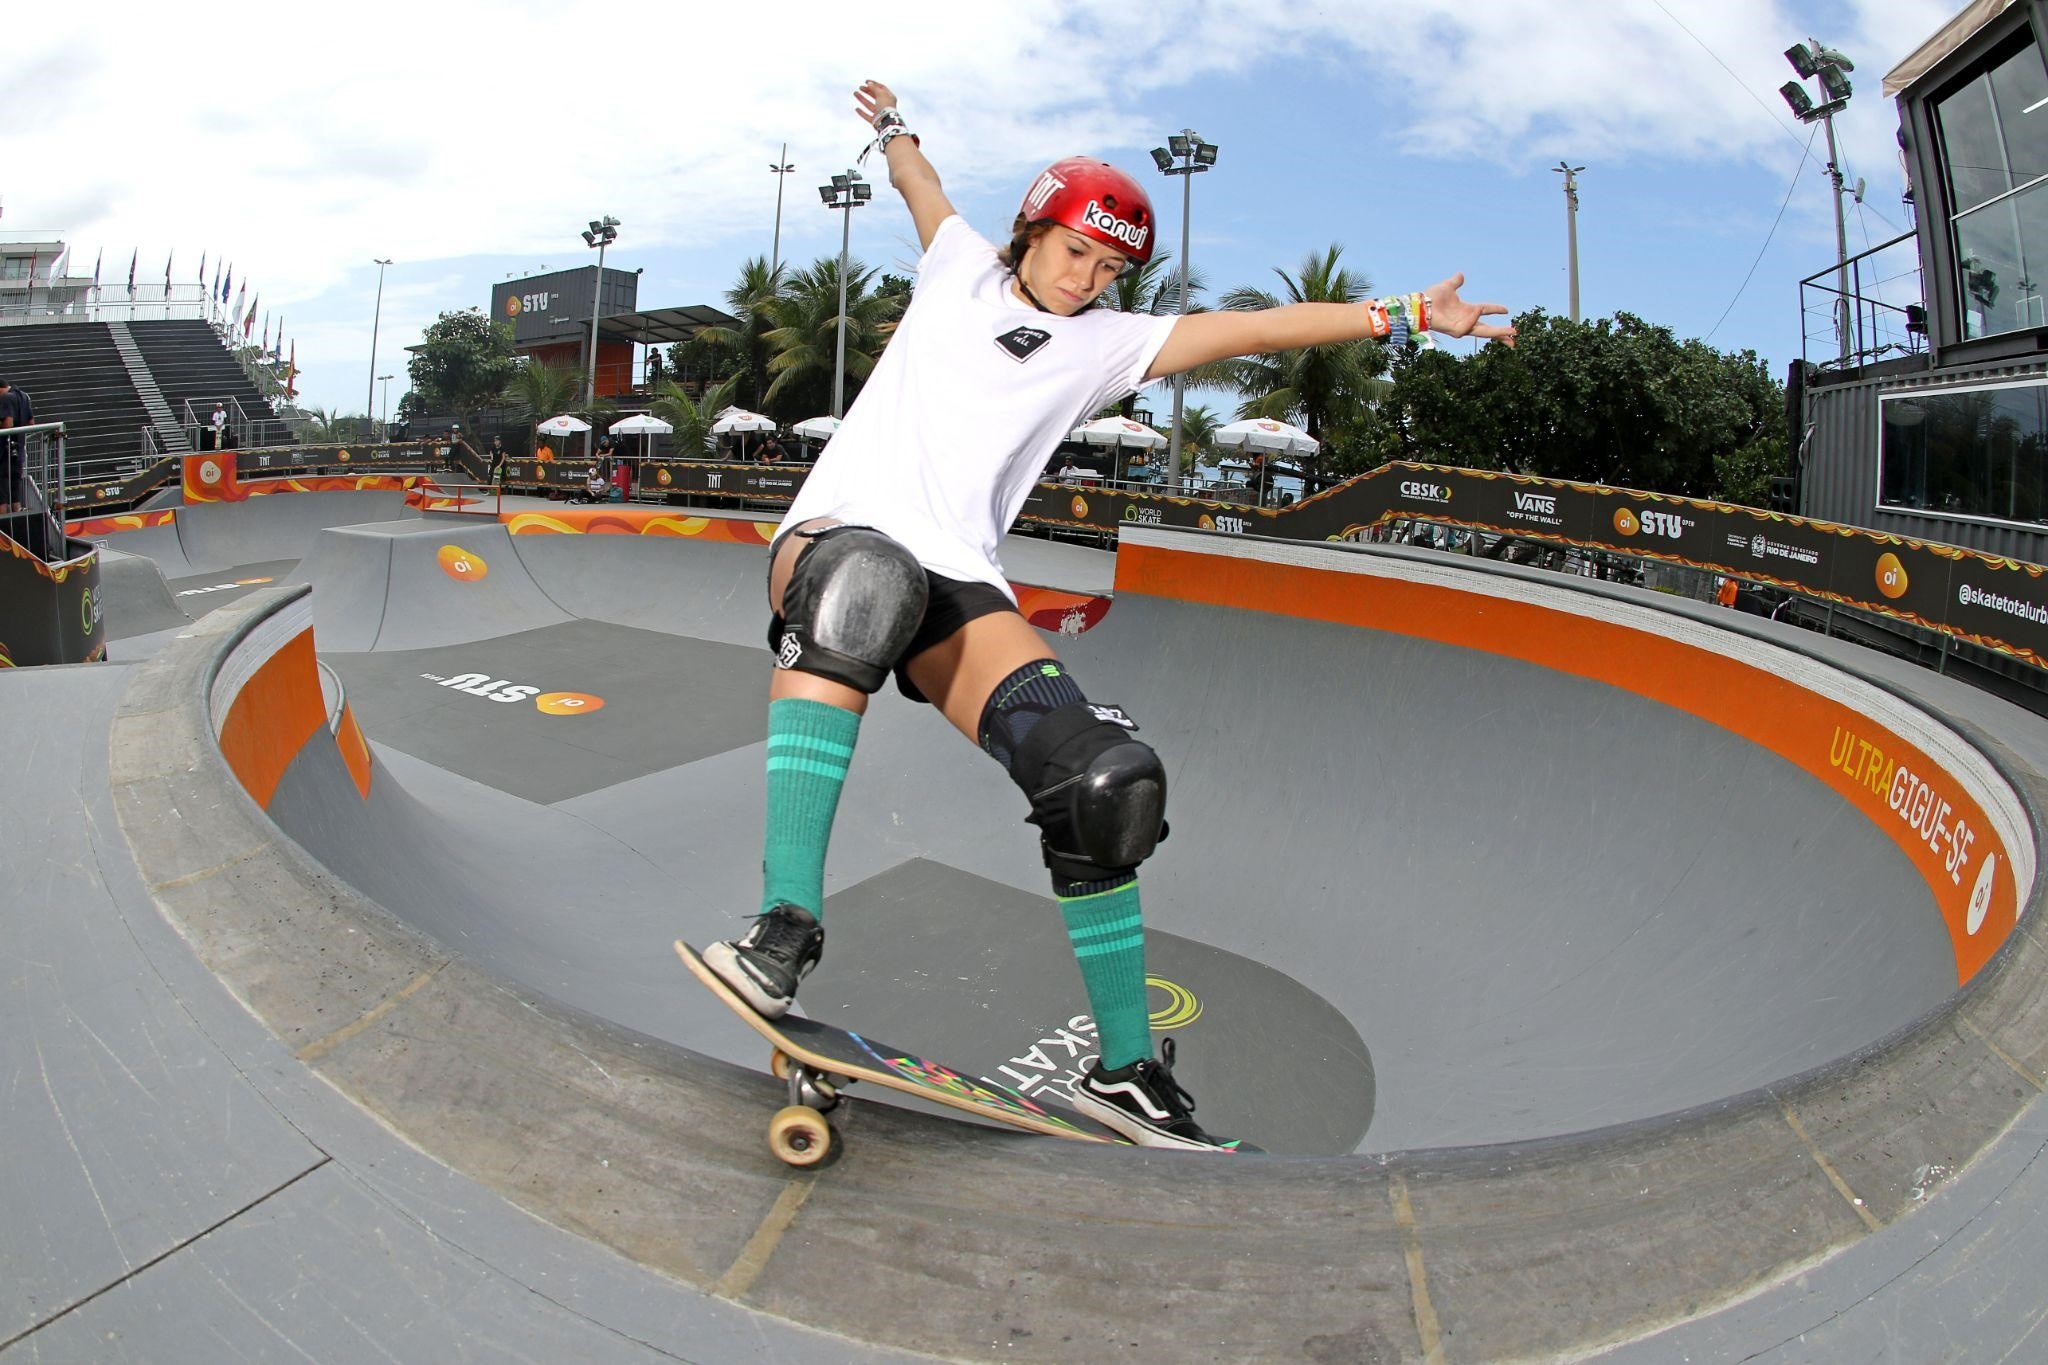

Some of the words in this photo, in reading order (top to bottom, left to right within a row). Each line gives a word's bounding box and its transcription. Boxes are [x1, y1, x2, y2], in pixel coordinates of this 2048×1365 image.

[1028, 171, 1066, 210] TNT
[1083, 201, 1148, 249] kanui
[523, 292, 548, 313] STU
[259, 456, 271, 467] TNT
[206, 468, 215, 478] oi
[707, 474, 722, 488] TNT
[1076, 502, 1083, 512] oi
[1514, 491, 1557, 514] VANS
[1138, 515, 1161, 525] SKATE
[1139, 508, 1162, 517] WORLD
[1525, 513, 1539, 522] THE
[1216, 515, 1243, 534] STU
[1620, 517, 1630, 528] oi
[1640, 510, 1682, 539] STU
[1766, 546, 1779, 555] RIO
[1779, 548, 1789, 558] DE
[1789, 551, 1818, 564] JANEIRO
[1799, 548, 1819, 556] ESTADO
[454, 556, 472, 573] oi
[1884, 568, 1898, 586] oi
[1959, 584, 2048, 624] @skatetotalurb
[437, 673, 541, 703] STU
[1830, 726, 1975, 886] ULTRAGIGUE-SE
[1975, 882, 1989, 912] oi
